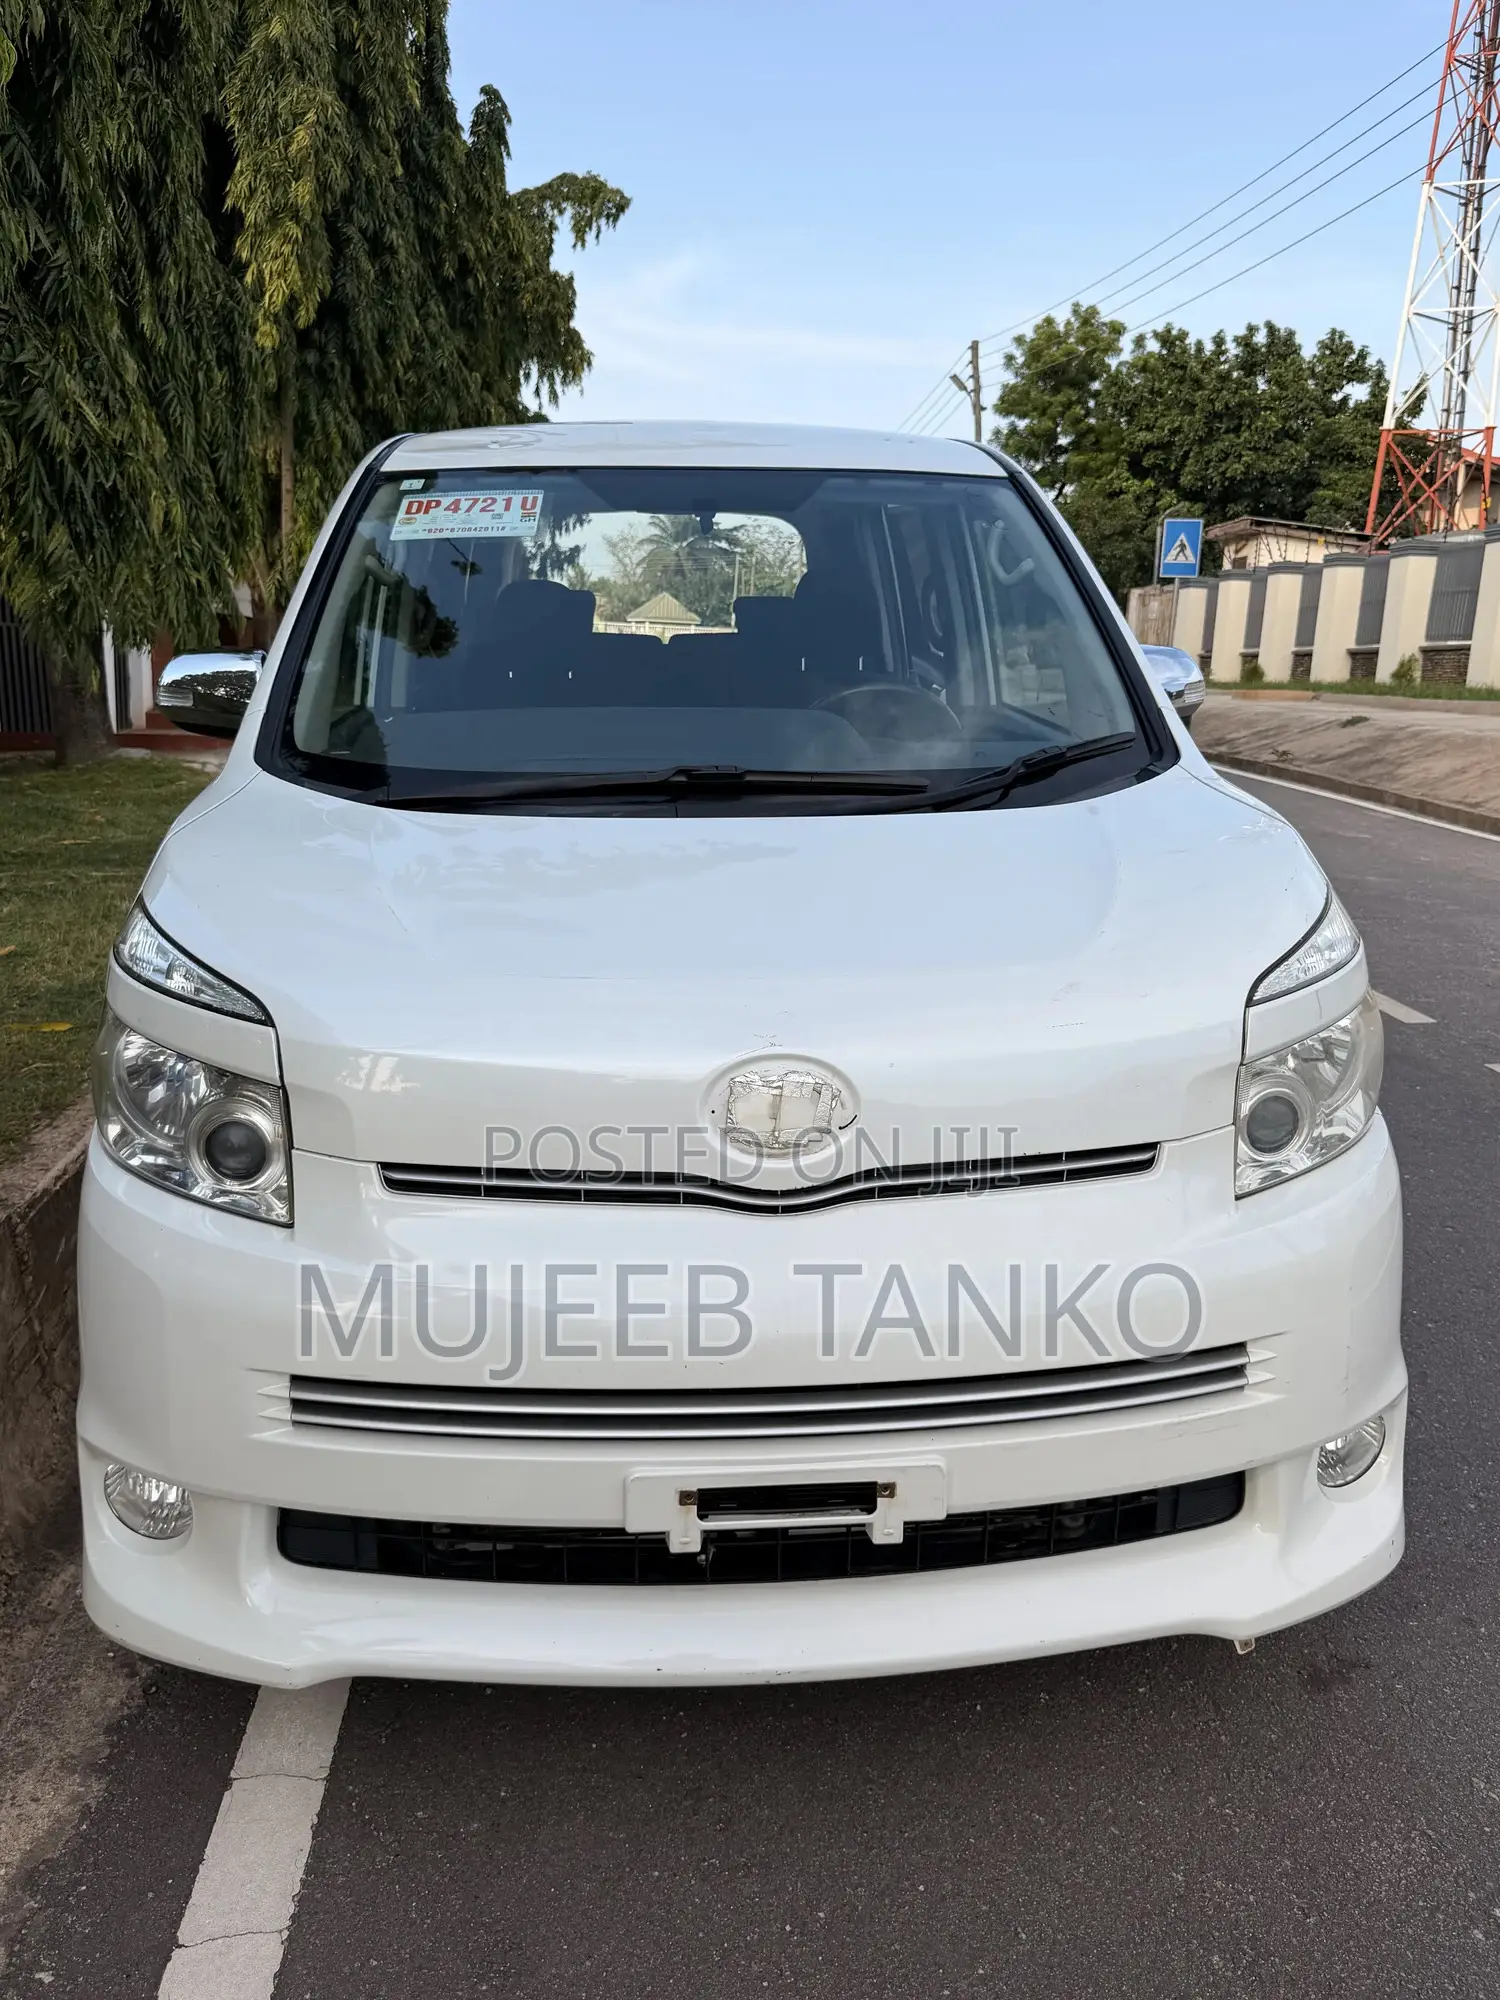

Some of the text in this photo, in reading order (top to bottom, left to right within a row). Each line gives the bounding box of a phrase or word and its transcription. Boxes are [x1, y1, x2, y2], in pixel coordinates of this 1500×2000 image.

[404, 496, 539, 515] DP 4721 U
